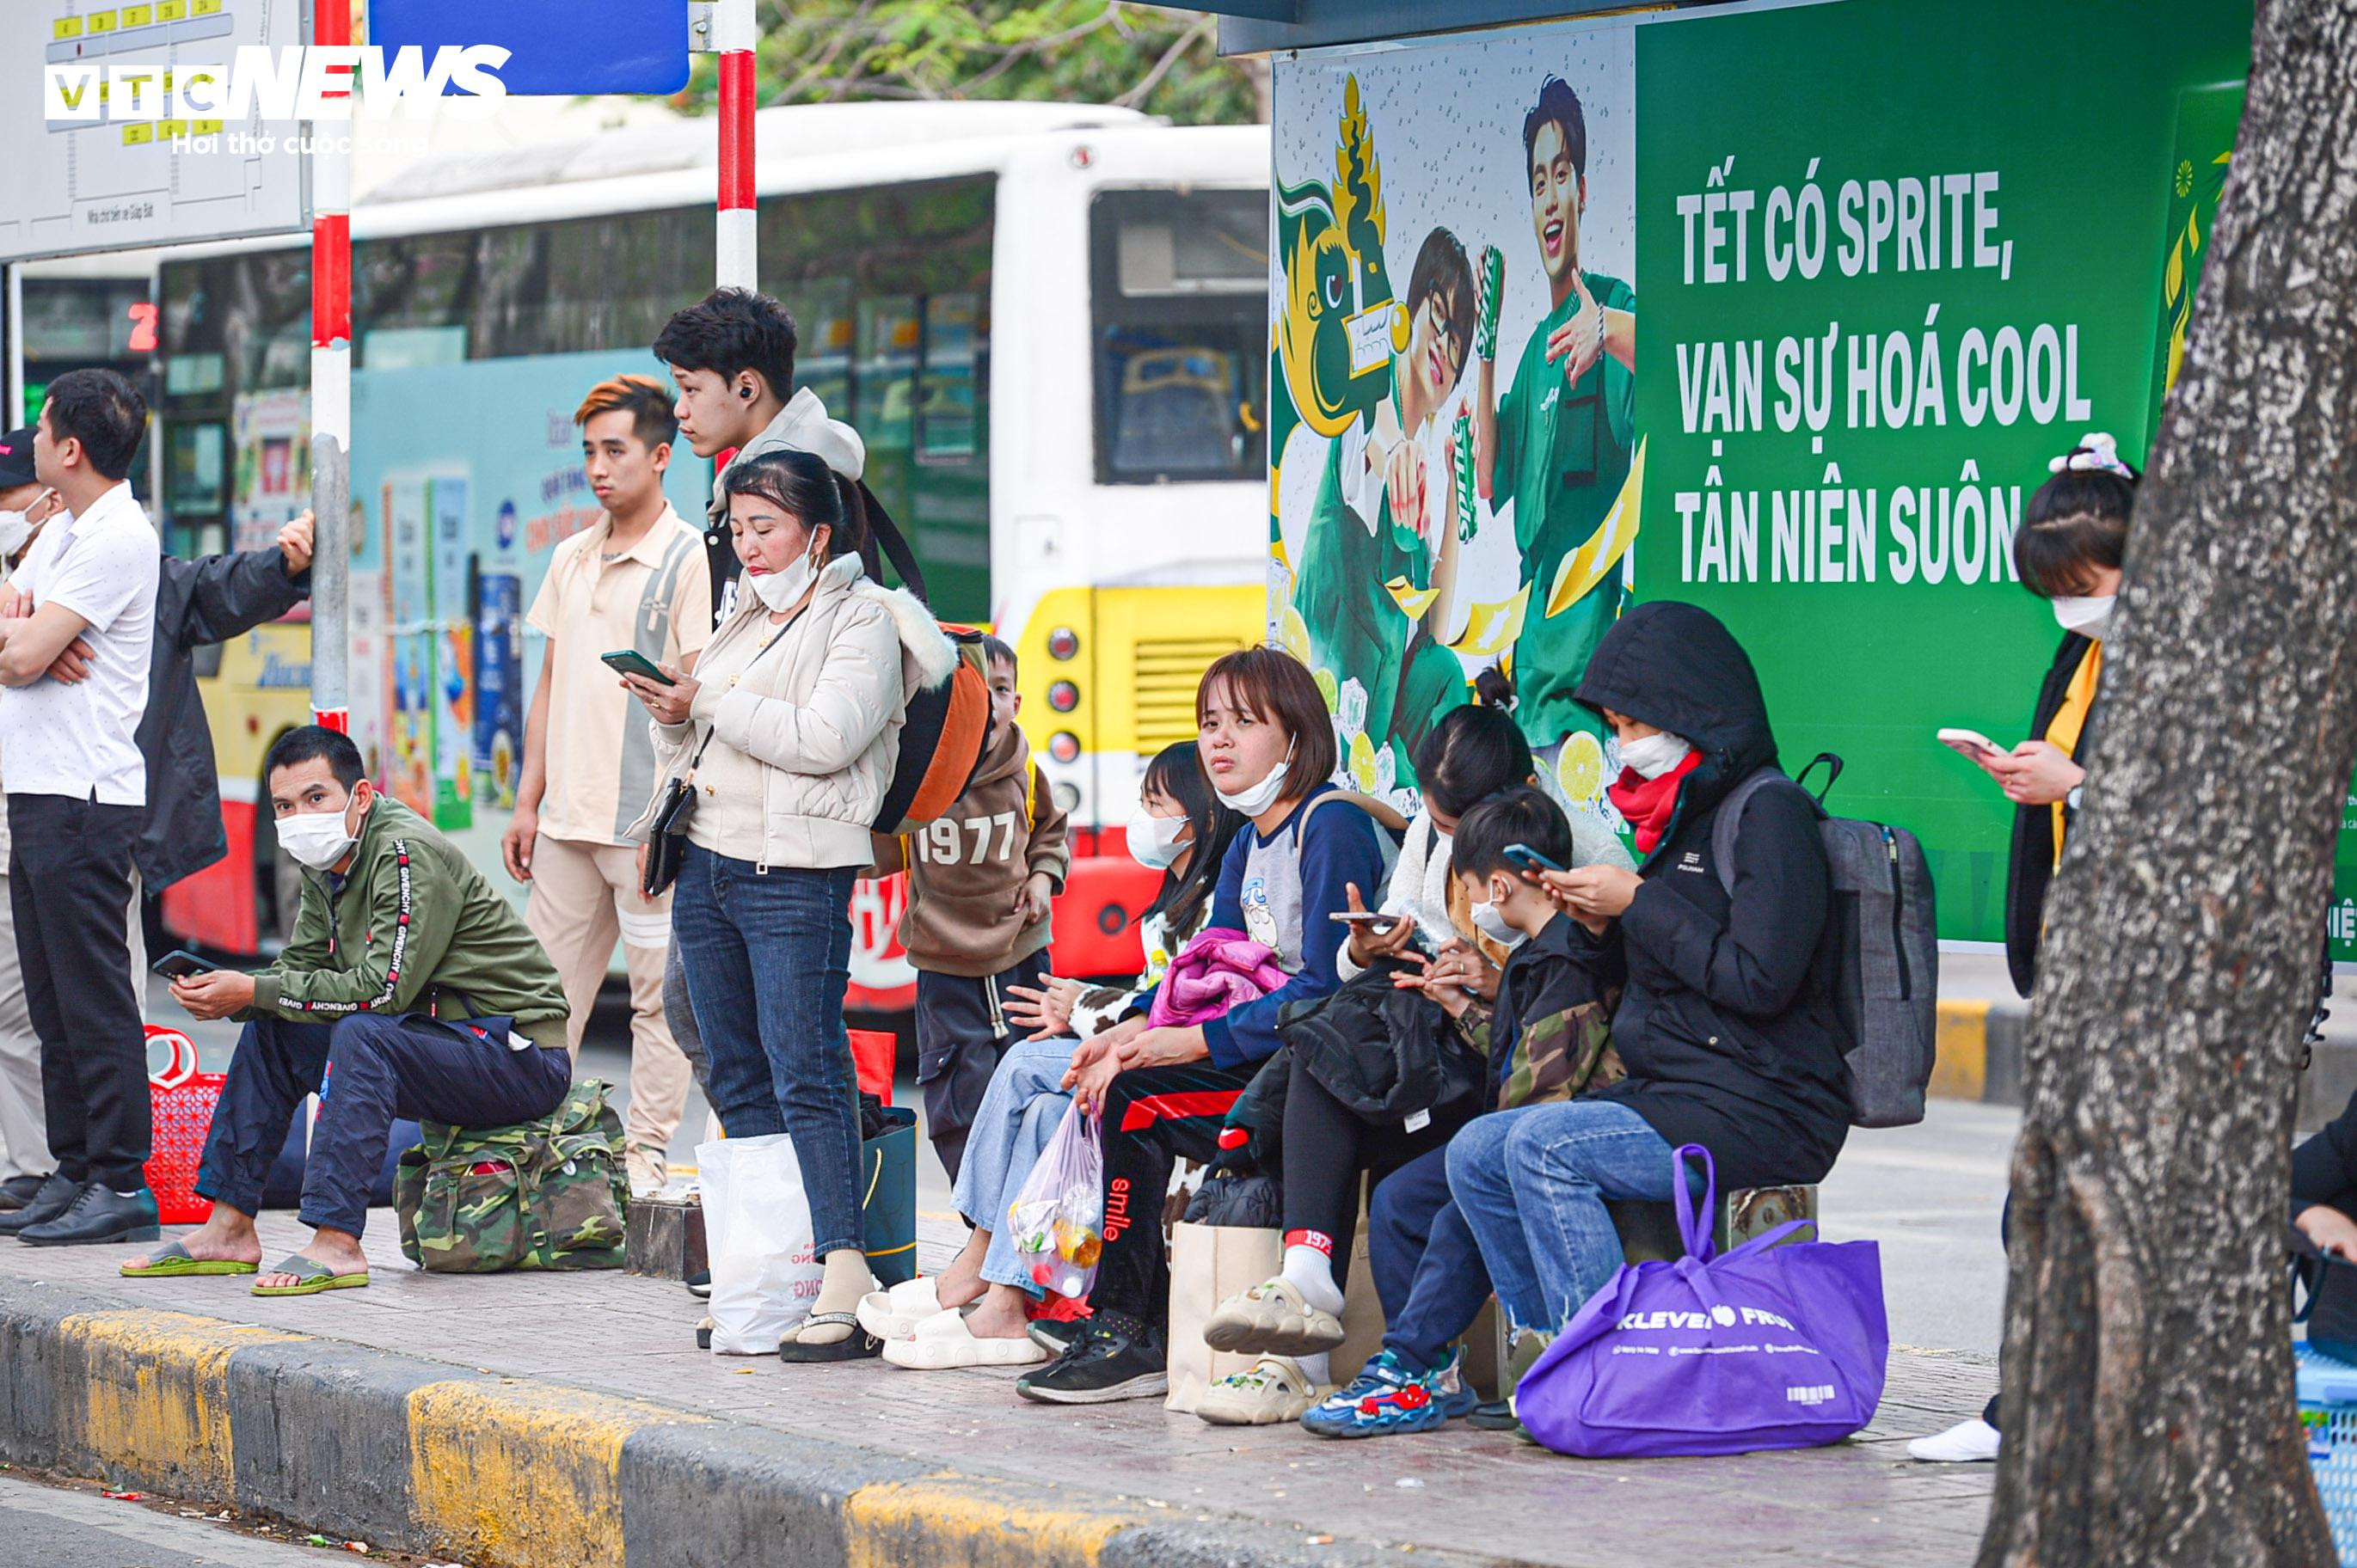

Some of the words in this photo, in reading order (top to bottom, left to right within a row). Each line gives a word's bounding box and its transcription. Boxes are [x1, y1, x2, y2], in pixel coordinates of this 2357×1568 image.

[1677, 155, 1754, 285] TẾT
[1765, 157, 1826, 282] CÓ
[1837, 171, 2013, 280] SPRITE,
[1676, 340, 1764, 456] VẠN
[1774, 322, 1838, 454] SỰ
[1847, 303, 1947, 430] HOÁ
[1957, 323, 2091, 427] COOL
[1675, 465, 1759, 583] TÂN
[1772, 461, 1877, 583] NIÊN
[1888, 458, 2022, 585] SUÔN
[918, 811, 1016, 866] 1977
[400, 867, 410, 915] GIVENCHY
[392, 925, 408, 973] GIVENCHY
[311, 1001, 358, 1011] GIVENCHY
[1103, 1178, 1131, 1241] smile
